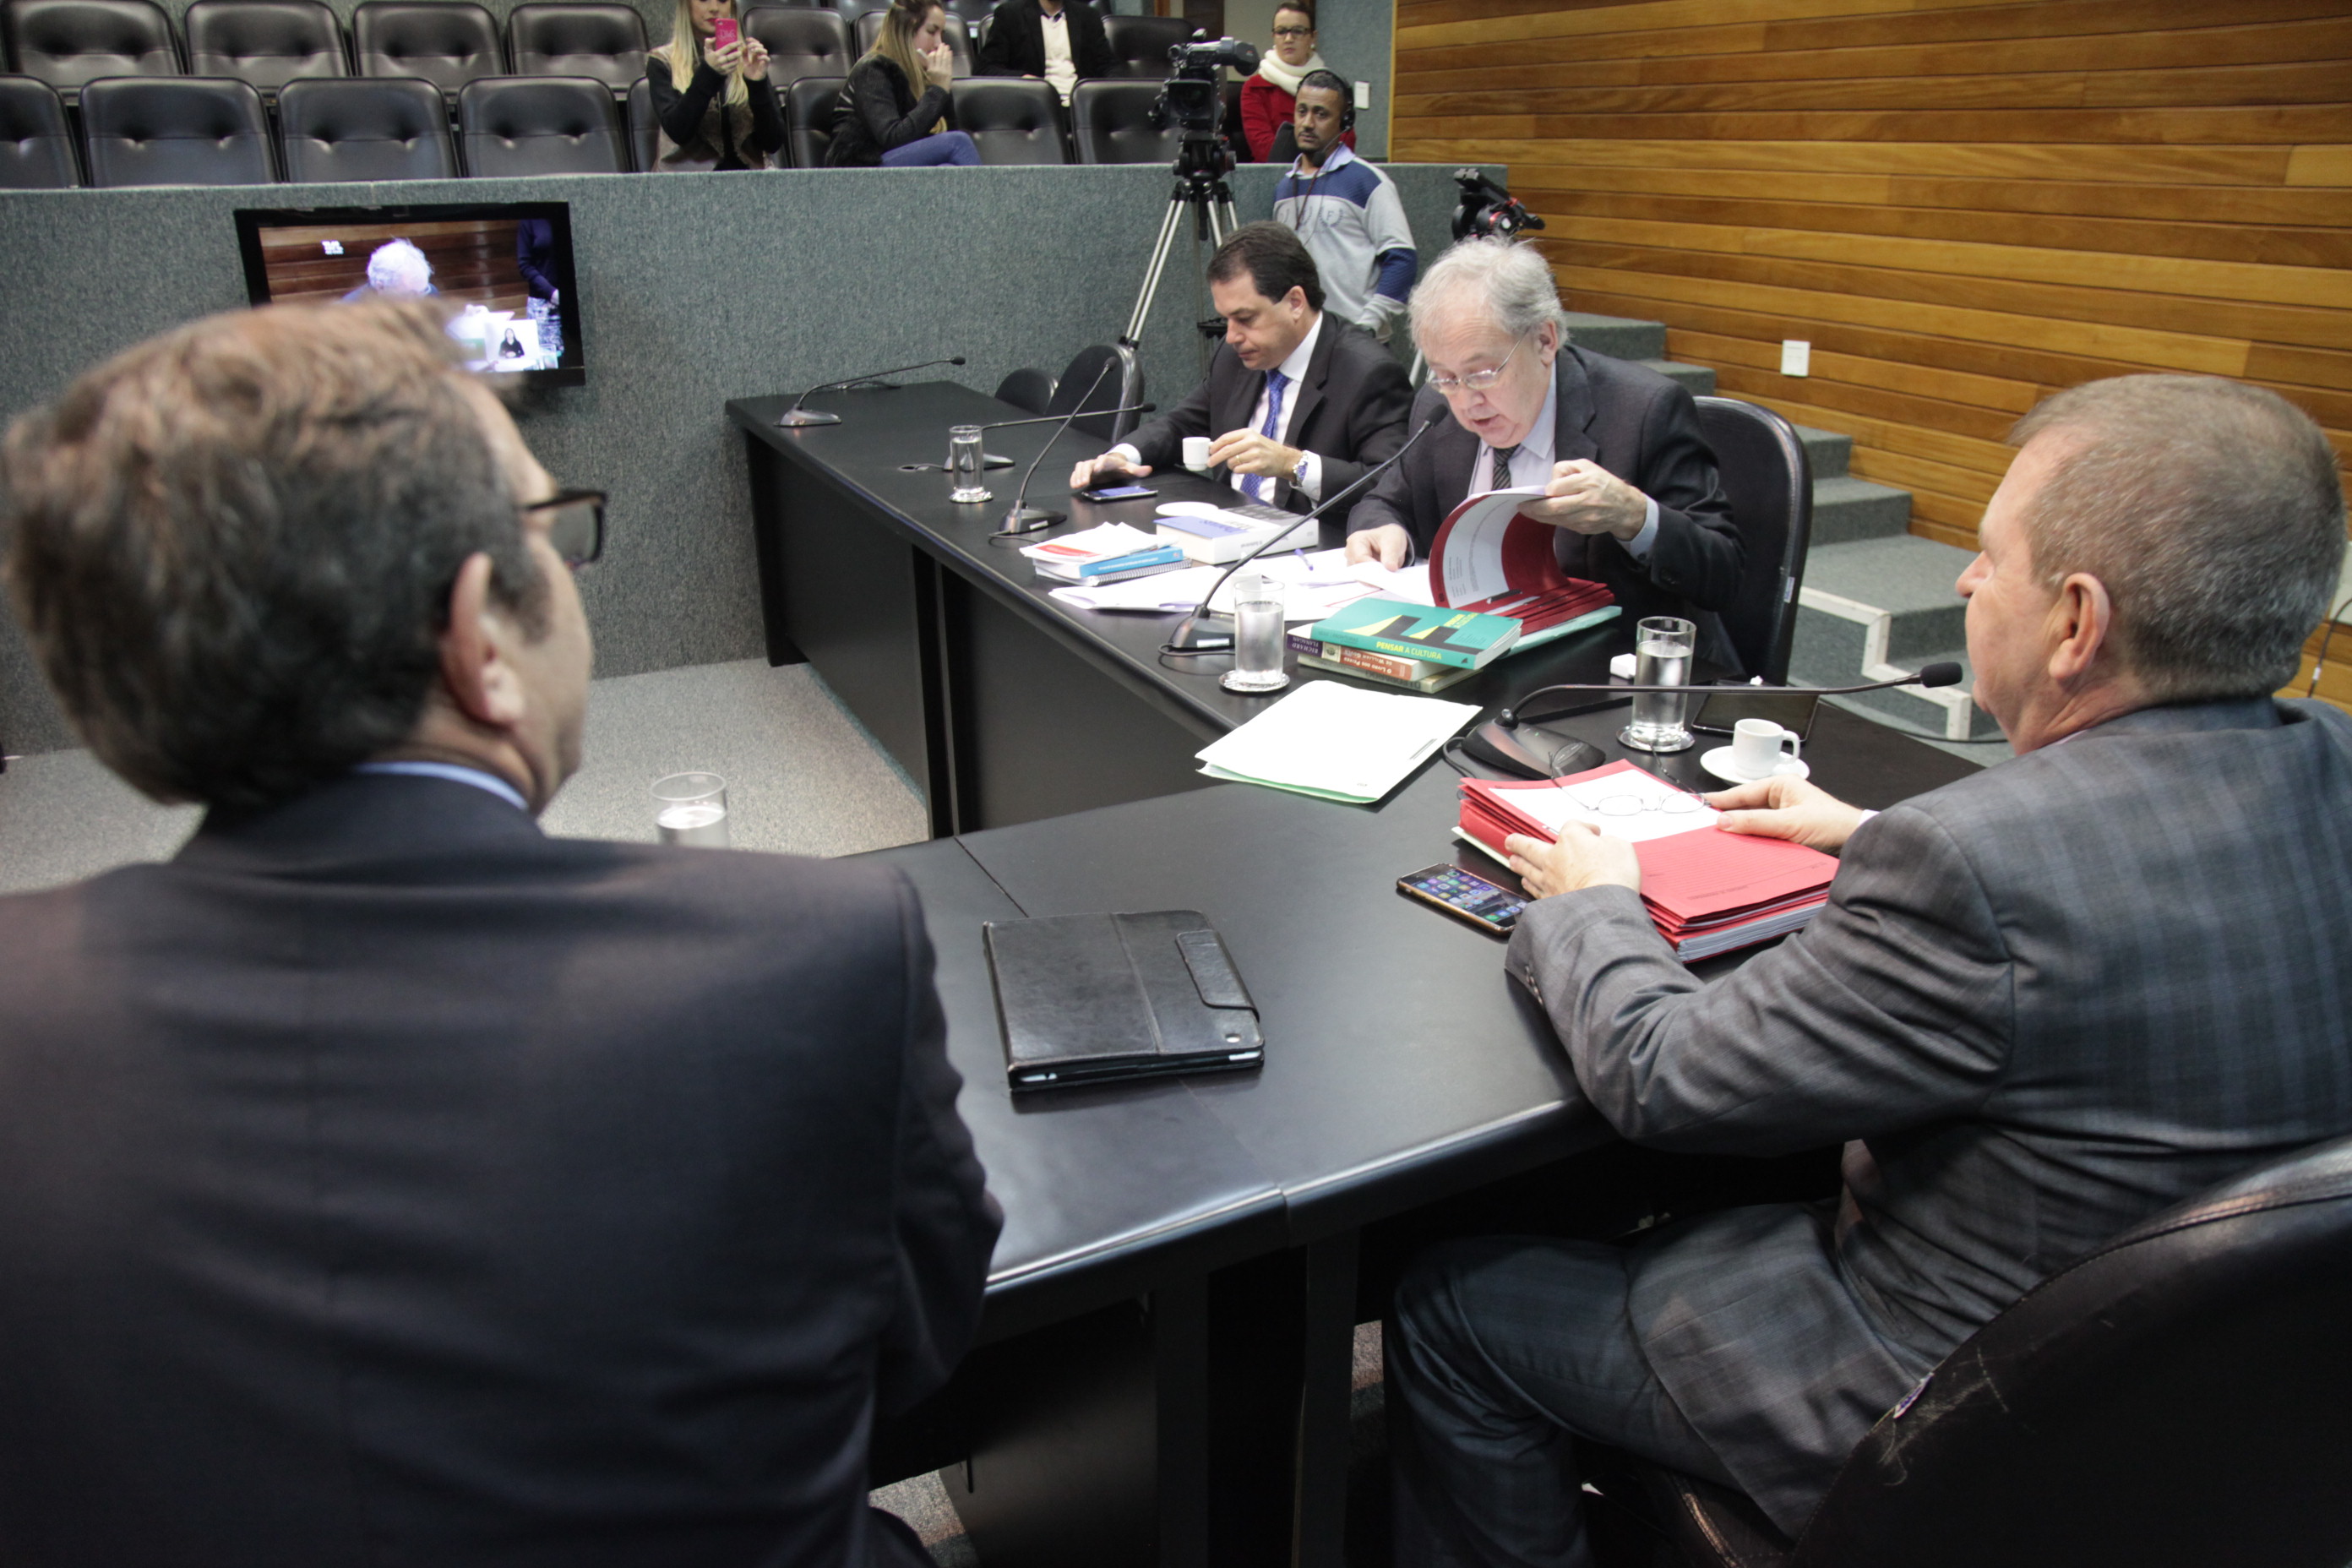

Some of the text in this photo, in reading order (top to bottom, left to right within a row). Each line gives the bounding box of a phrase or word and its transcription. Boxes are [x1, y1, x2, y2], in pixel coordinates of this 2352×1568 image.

[1293, 636, 1319, 647] FLANAGAN
[1292, 643, 1319, 654] RICHARD
[1376, 641, 1404, 653] PENSAR
[1411, 647, 1442, 659] CULTURA
